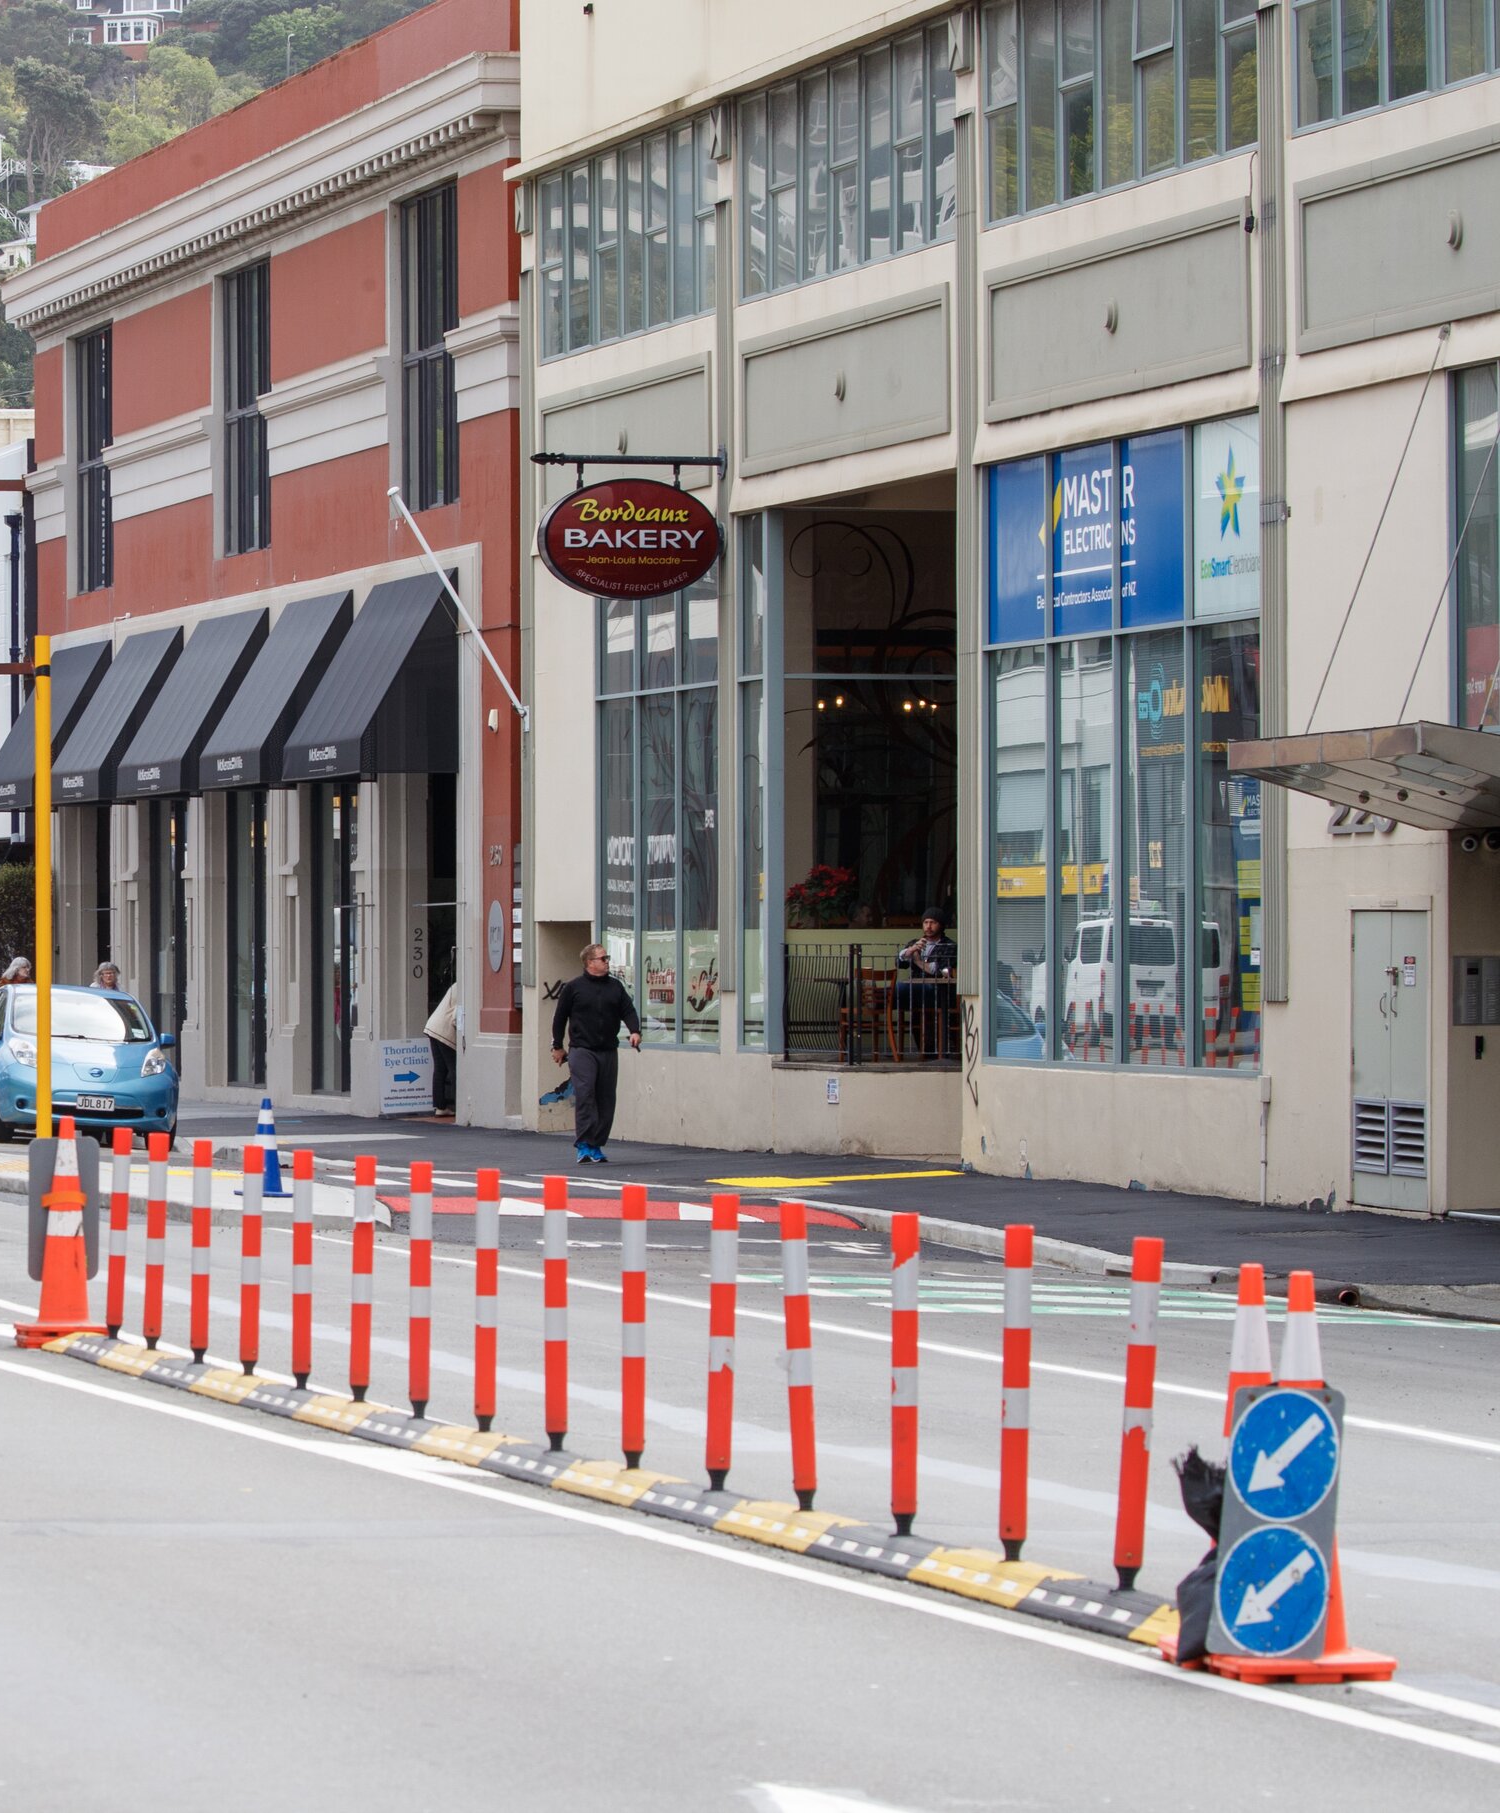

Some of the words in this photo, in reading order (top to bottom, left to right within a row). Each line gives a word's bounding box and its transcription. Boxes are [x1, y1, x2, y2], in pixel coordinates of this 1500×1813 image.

[1063, 465, 1135, 519] MASTR
[572, 498, 689, 522] Bordeaux
[564, 528, 705, 549] BAKERY
[1063, 518, 1136, 555] ELECTRICNS
[585, 555, 636, 565] Jean-Louis
[637, 555, 681, 565] Macadre
[575, 568, 622, 591] SPECIALIST
[624, 582, 660, 592] FRENCH
[662, 570, 690, 588] BAKER
[412, 927, 424, 980] 230
[383, 1044, 429, 1056] Thorndon
[384, 1057, 401, 1069] Eye
[402, 1055, 429, 1066] Clinic
[78, 1097, 113, 1110] JDL817
